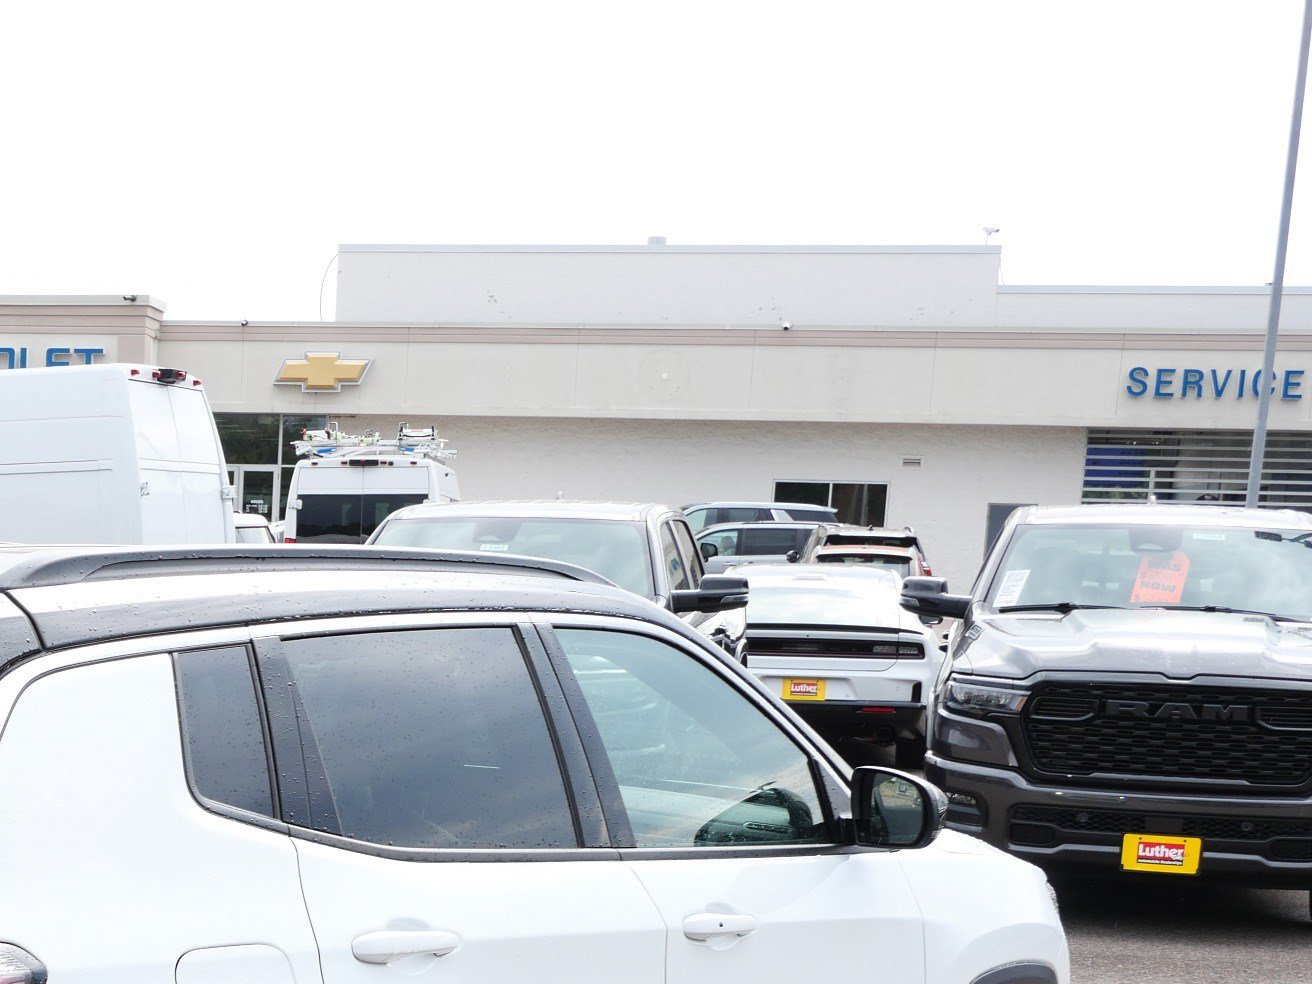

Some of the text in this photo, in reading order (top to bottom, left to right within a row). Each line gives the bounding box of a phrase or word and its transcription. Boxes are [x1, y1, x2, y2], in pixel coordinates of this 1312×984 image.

[1126, 366, 1305, 400] SERVICE
[791, 684, 818, 692] Luther
[1105, 699, 1252, 722] RAM
[1138, 843, 1184, 859] Luther
